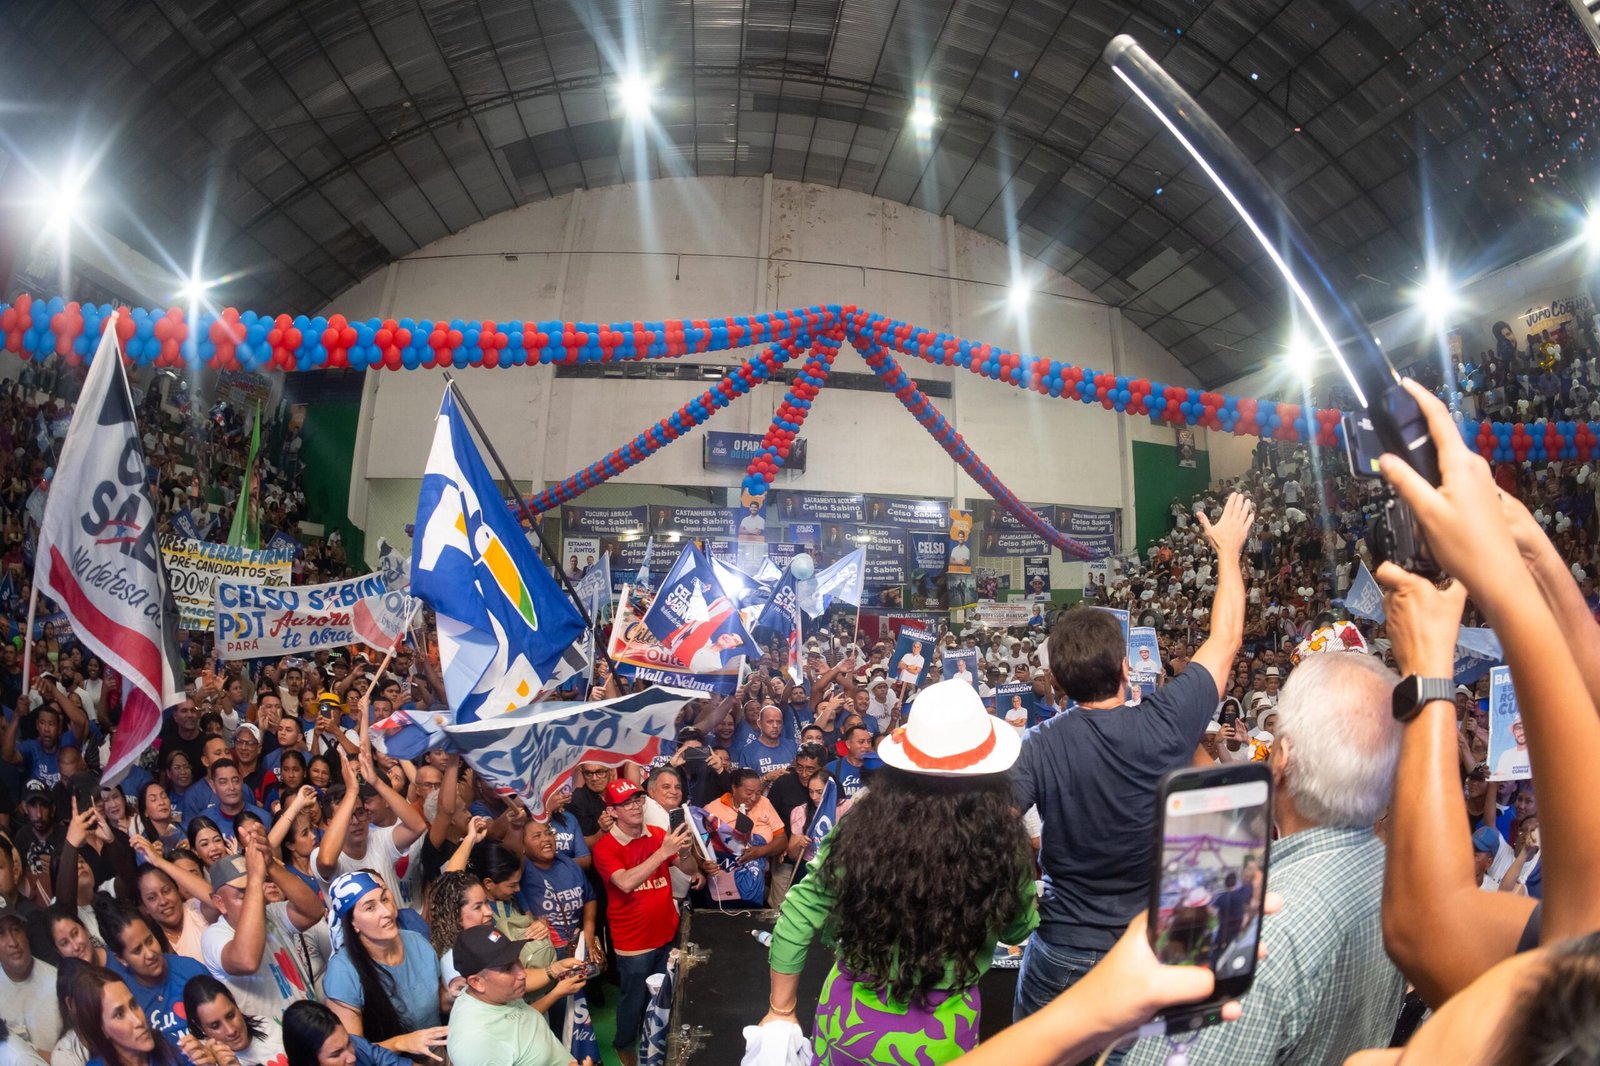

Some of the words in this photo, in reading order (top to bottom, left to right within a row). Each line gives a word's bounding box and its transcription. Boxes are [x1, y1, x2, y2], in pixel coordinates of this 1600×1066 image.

[734, 439, 740, 450] O
[741, 440, 762, 451] PAR
[731, 450, 740, 458] DO
[610, 510, 632, 518] ABRAÇA
[830, 504, 861, 512] Sabino
[887, 508, 914, 517] Celso
[914, 510, 943, 518] Sabino
[580, 517, 606, 525] Celso
[608, 517, 639, 526] Sabino
[673, 517, 701, 525] Celso
[702, 517, 735, 525] Sabino
[1091, 518, 1112, 526] Sabino
[872, 537, 902, 545] Sabino
[1021, 539, 1046, 547] Sabino
[188, 543, 199, 555] DA
[199, 542, 295, 565] TERRA-FIRME
[621, 549, 646, 557] Celso
[651, 549, 681, 557] Sabino
[918, 542, 945, 554] CELSO
[169, 554, 267, 578] PRÉ-CANDIDATOS
[1026, 567, 1049, 576] ESPERANÇA
[71, 545, 92, 577] Na
[85, 561, 149, 609] defesa
[219, 583, 300, 611] CELSO
[308, 574, 388, 611] SABIN
[219, 610, 267, 641] PDT
[270, 611, 351, 637] Aurora
[281, 627, 302, 649] te
[309, 627, 353, 648] abraç
[902, 628, 937, 642] MANESCHY
[227, 639, 259, 652] PARÁ
[647, 649, 685, 667] Oute
[944, 651, 976, 659] MANESCHY
[635, 666, 664, 686] Wall
[664, 674, 673, 684] e
[672, 672, 714, 693] Nelma
[1494, 673, 1511, 685] BA
[997, 685, 1033, 694] MANESCHY
[1499, 692, 1515, 703] RO
[1498, 703, 1518, 715] CU
[759, 757, 771, 766] EU
[842, 774, 860, 786] Eu
[616, 781, 637, 794] LULA
[653, 876, 668, 889] CELSO
[542, 900, 554, 911] O
